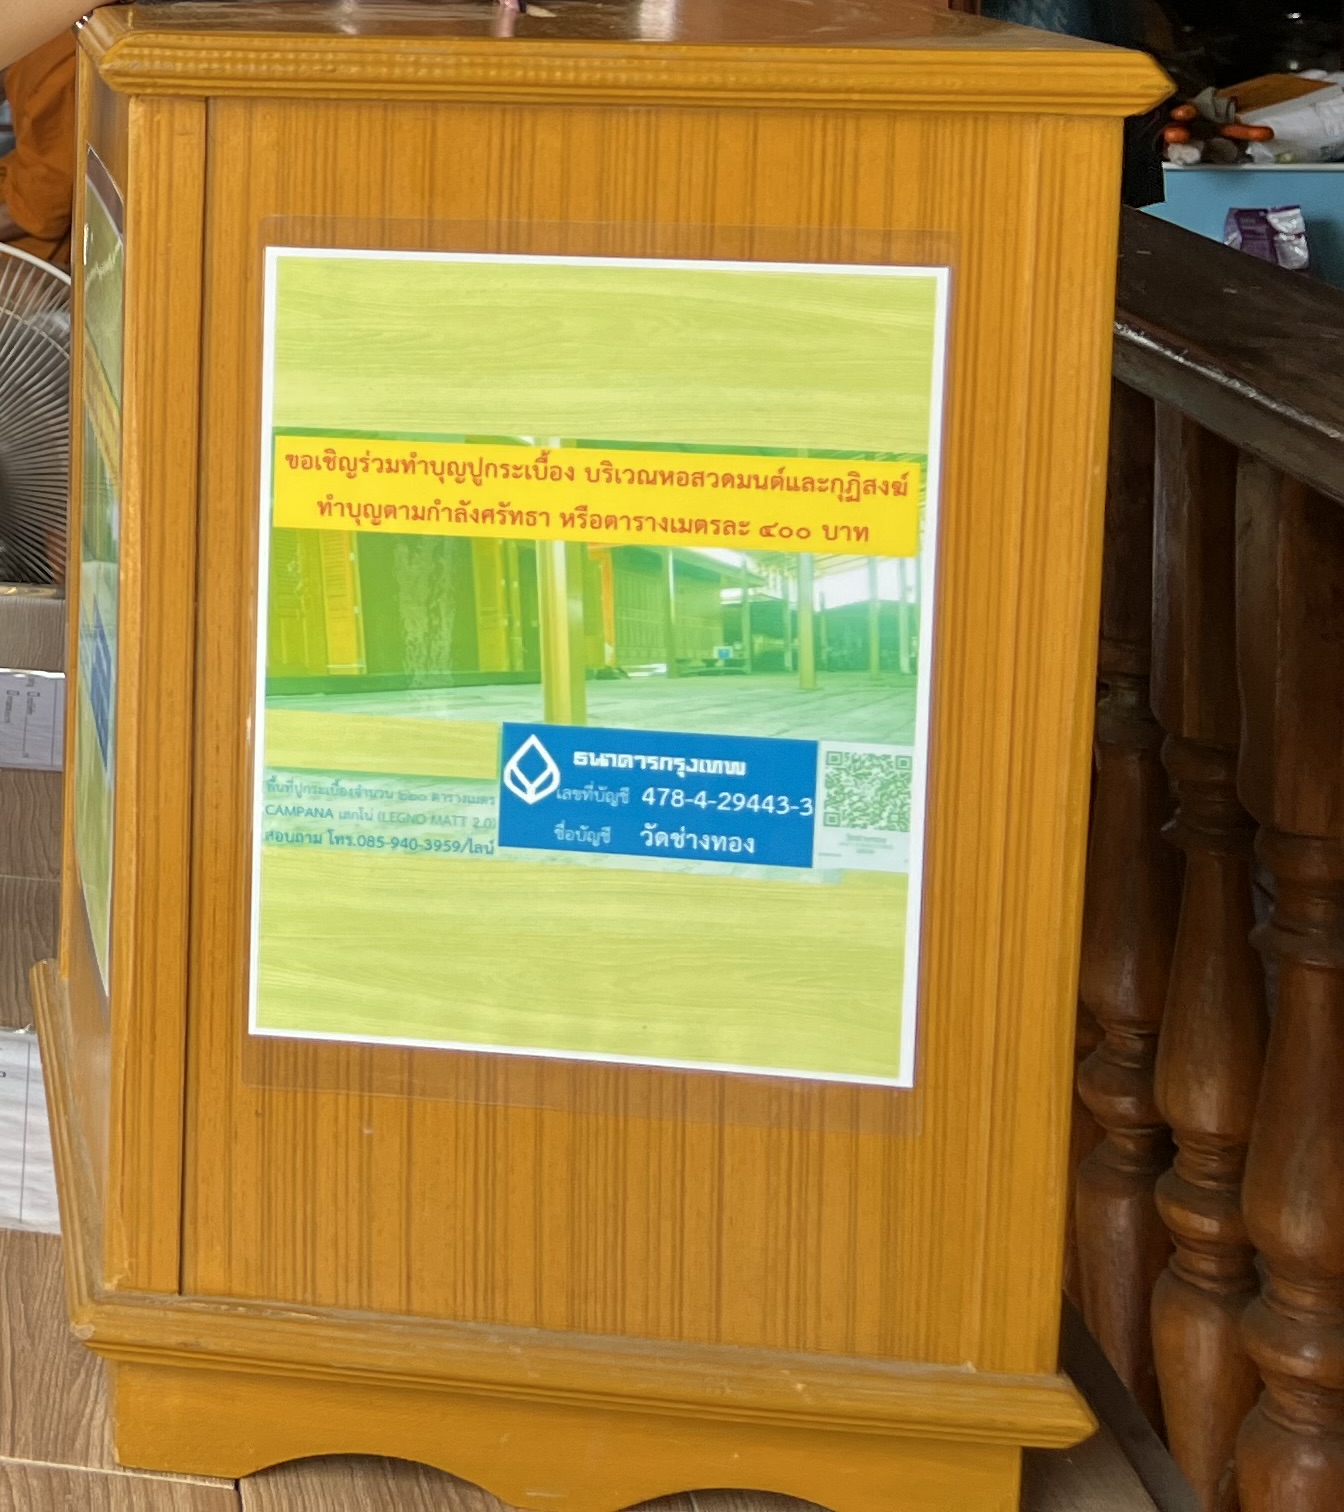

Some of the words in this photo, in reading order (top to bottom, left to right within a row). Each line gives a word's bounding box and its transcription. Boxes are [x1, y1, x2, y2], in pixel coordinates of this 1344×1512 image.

[284, 448, 575, 486] ขอเชิญร่วมทำบุญปูกระเบื้อง
[585, 460, 909, 502] บริเวณหอสวดมนต์และกุฏิสงฆ์
[317, 494, 551, 527] ทำบุญตามกำลังศรัทธา
[559, 504, 751, 536] หรือตารางเมตรละ
[759, 520, 812, 540] ๔๐๐
[822, 521, 869, 542] บาท
[573, 750, 747, 777] ธนาคารกรุงเทพ
[264, 804, 334, 820] CAMPANA
[556, 781, 631, 807] เลขที่บัญชี
[641, 786, 814, 817] 478-4-29443-3
[264, 829, 323, 846] สอบถาม
[553, 819, 611, 847] ชื่อบัญชี
[639, 822, 755, 854] วัดช่างทอง
